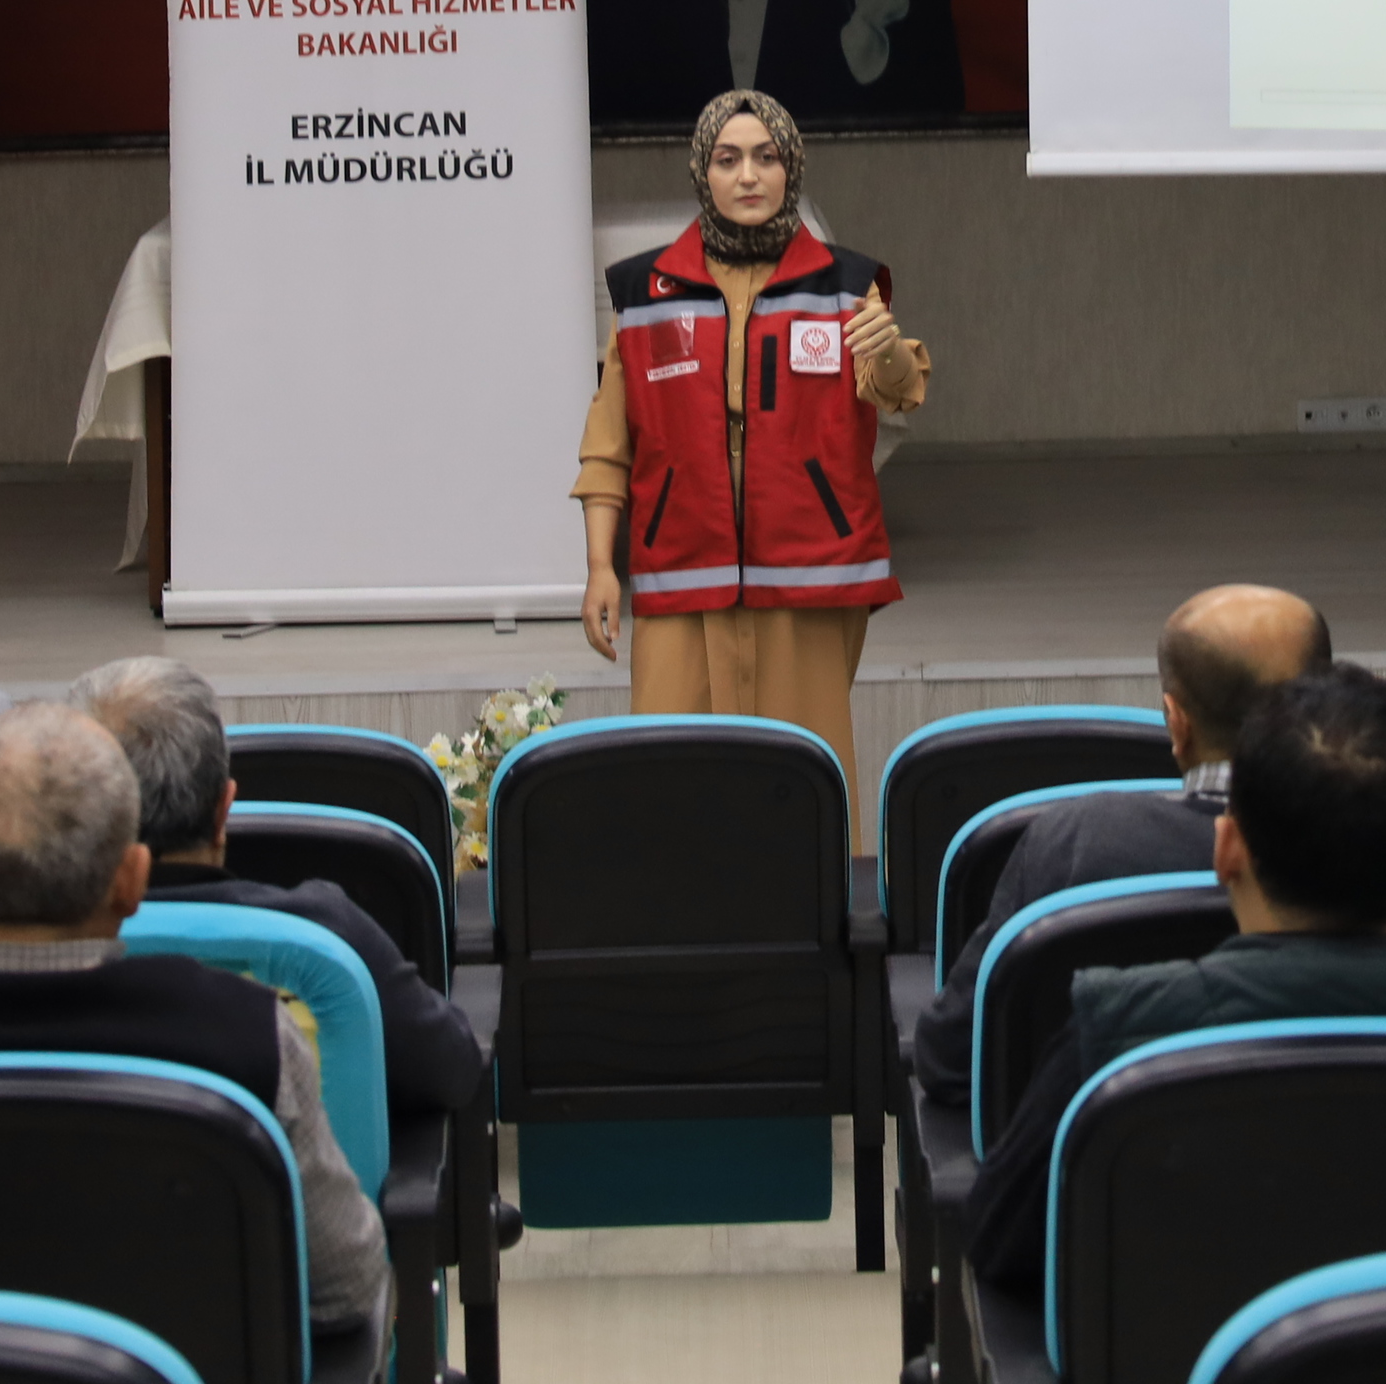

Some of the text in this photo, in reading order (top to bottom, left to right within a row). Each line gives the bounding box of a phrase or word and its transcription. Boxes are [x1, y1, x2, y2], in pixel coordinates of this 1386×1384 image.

[297, 25, 457, 57] BAKANLIĞI
[291, 108, 467, 140] ERZİNCAN
[245, 148, 513, 185] İL MÜDÜRLÜĞÜ
